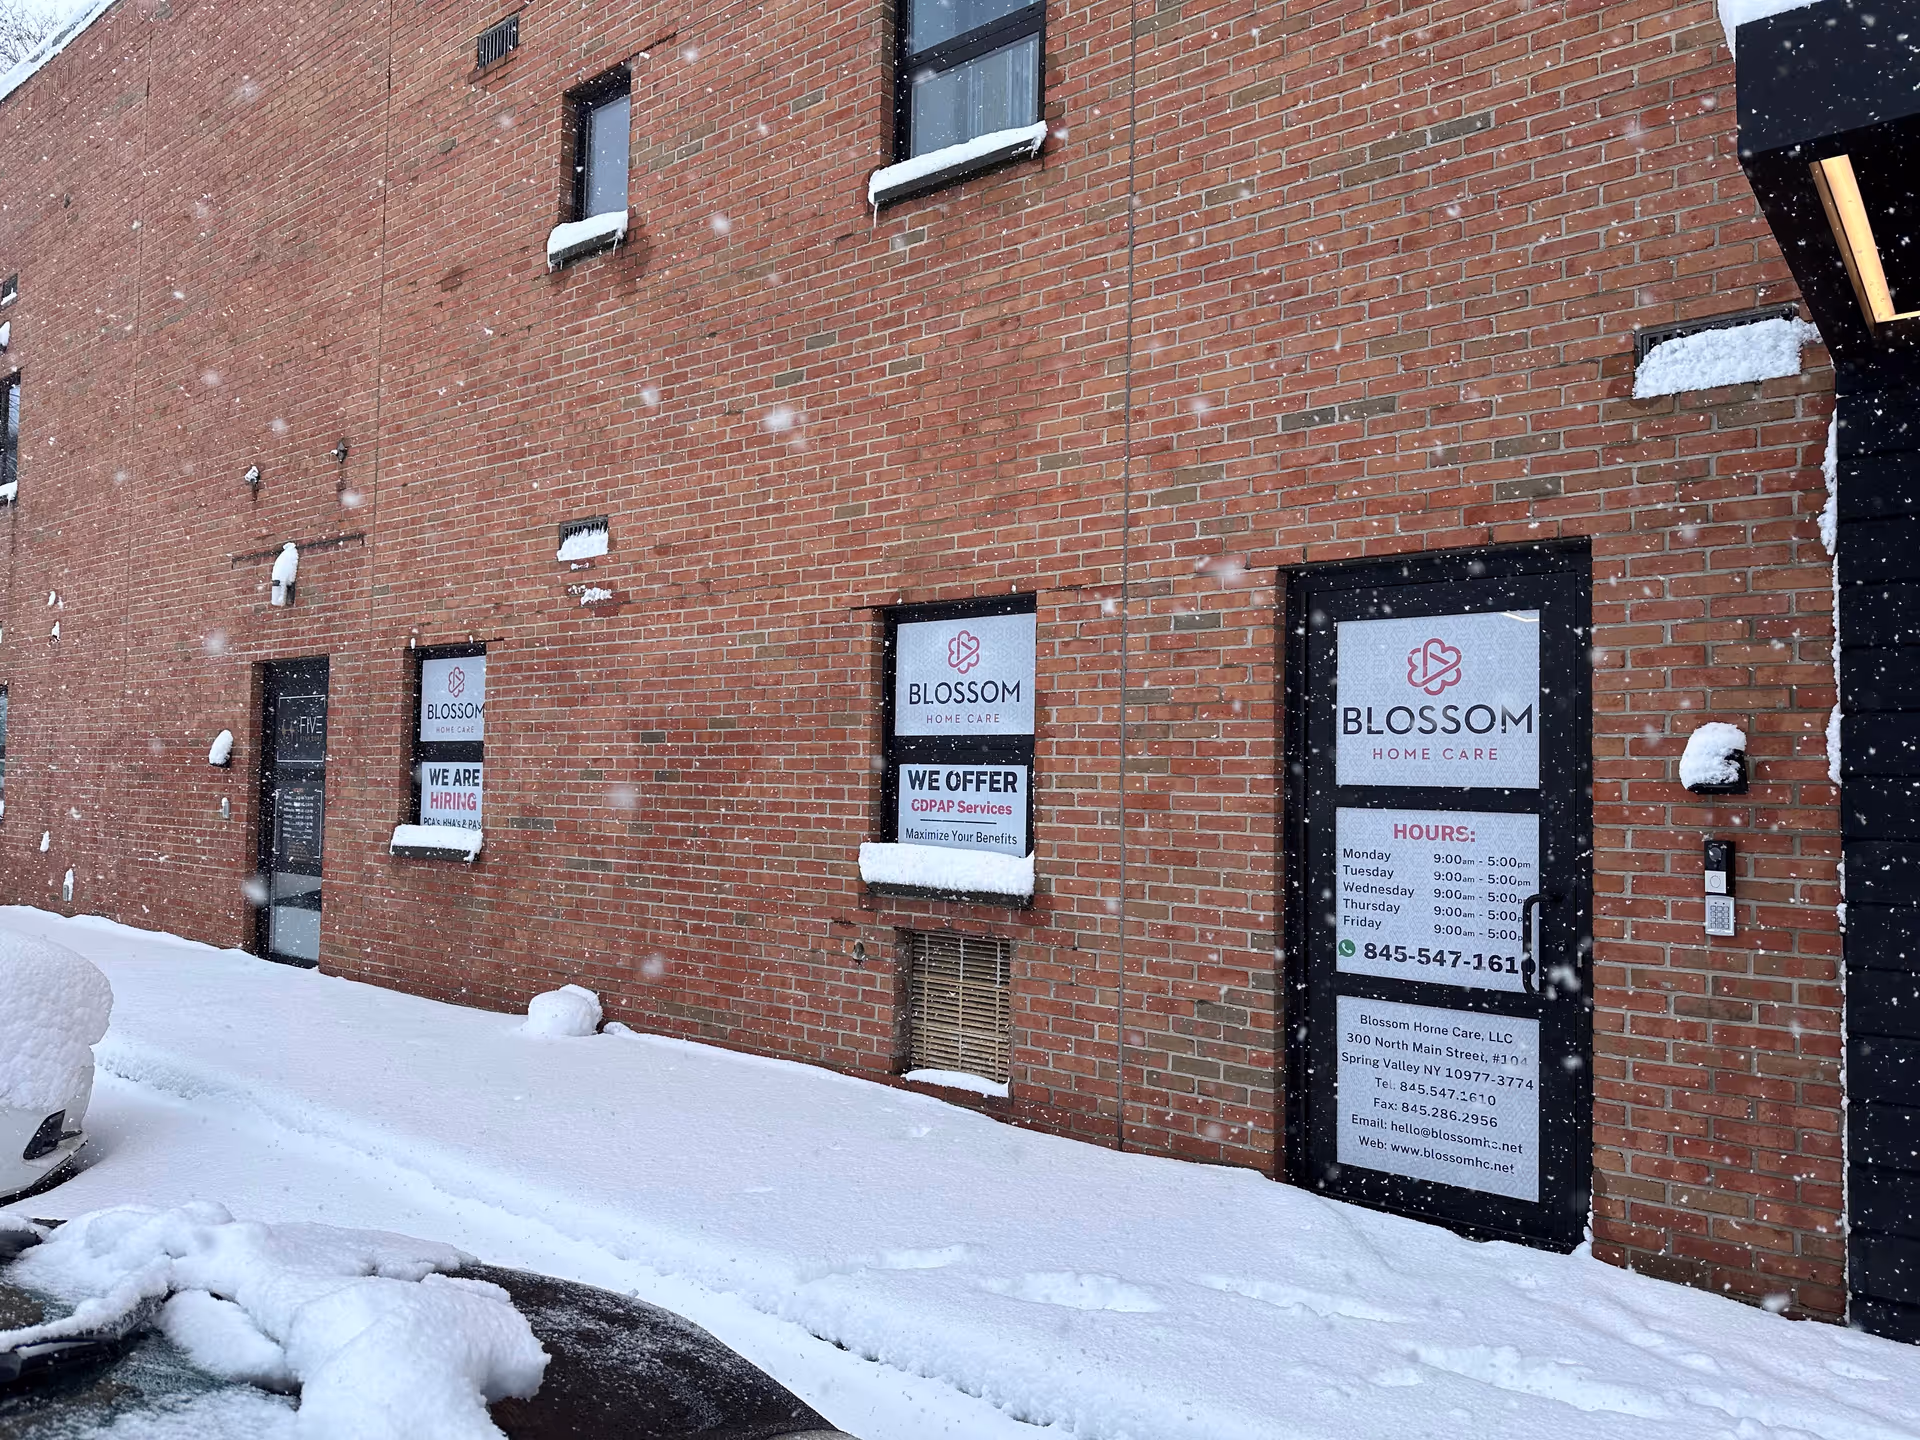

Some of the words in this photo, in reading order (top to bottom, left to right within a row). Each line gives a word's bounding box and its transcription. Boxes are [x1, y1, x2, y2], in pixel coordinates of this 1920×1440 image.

[909, 680, 1021, 705] BLOSSOM
[427, 702, 485, 720] BLOSSOM
[926, 714, 961, 724] HOME
[967, 713, 1000, 723] CARE
[1342, 703, 1533, 735] BLOSSOM
[300, 715, 323, 734] FIVE
[457, 725, 474, 733] CARE
[1372, 748, 1431, 760] HOME
[1442, 748, 1498, 760] CARE
[429, 768, 449, 786] WE
[453, 768, 480, 787] ARE
[907, 769, 941, 791] WE
[945, 770, 1018, 793] OFFER
[430, 791, 477, 811] HIRING
[911, 798, 955, 813] CDPAP
[957, 800, 1013, 815] Services
[905, 827, 950, 841] Maximize
[951, 830, 974, 843] Your
[976, 831, 1018, 845] Benefits
[1393, 823, 1476, 842] HOURS:
[1343, 848, 1391, 862] Monday
[1433, 854, 1475, 865] 9:00am
[1487, 856, 1531, 870] 5:00pm
[1343, 865, 1394, 879] Tuesday
[1433, 872, 1475, 883] 9:00am
[1487, 874, 1531, 887] 5:00pm
[1343, 881, 1415, 897] Wednesday
[1433, 888, 1475, 900] 9:00am
[1487, 892, 1523, 905] 5:00p
[1343, 898, 1400, 914] Thursday
[1433, 906, 1475, 918] 9:00am
[1487, 910, 1523, 923] 5:00p
[1343, 915, 1382, 930] Friday
[1433, 925, 1475, 937] 9:00am
[1487, 929, 1523, 942] 5:00p
[1363, 942, 1519, 975] 845-547-161
[1360, 1014, 1410, 1031] Blossom
[1413, 1021, 1449, 1035] Home
[1452, 1027, 1485, 1042] Care,
[1489, 1031, 1513, 1044] LLC
[1347, 1032, 1371, 1045] 300
[1375, 1037, 1409, 1051] North
[1412, 1042, 1442, 1056] Main
[1446, 1047, 1488, 1063] Street,
[1341, 1051, 1380, 1069] Spring
[1382, 1058, 1420, 1075] Valley
[1424, 1064, 1441, 1076] NY
[1445, 1067, 1534, 1091] 10977-3774
[1400, 1081, 1496, 1106] 845.547.1610
[1373, 1097, 1398, 1111] Fax:
[1401, 1102, 1498, 1128] 845.286.2956
[1351, 1113, 1387, 1130] Email:
[1391, 1121, 1523, 1154] hello@blossomhc.net
[1358, 1135, 1387, 1150] Web:
[1390, 1143, 1515, 1174] www.blossomhc.net
